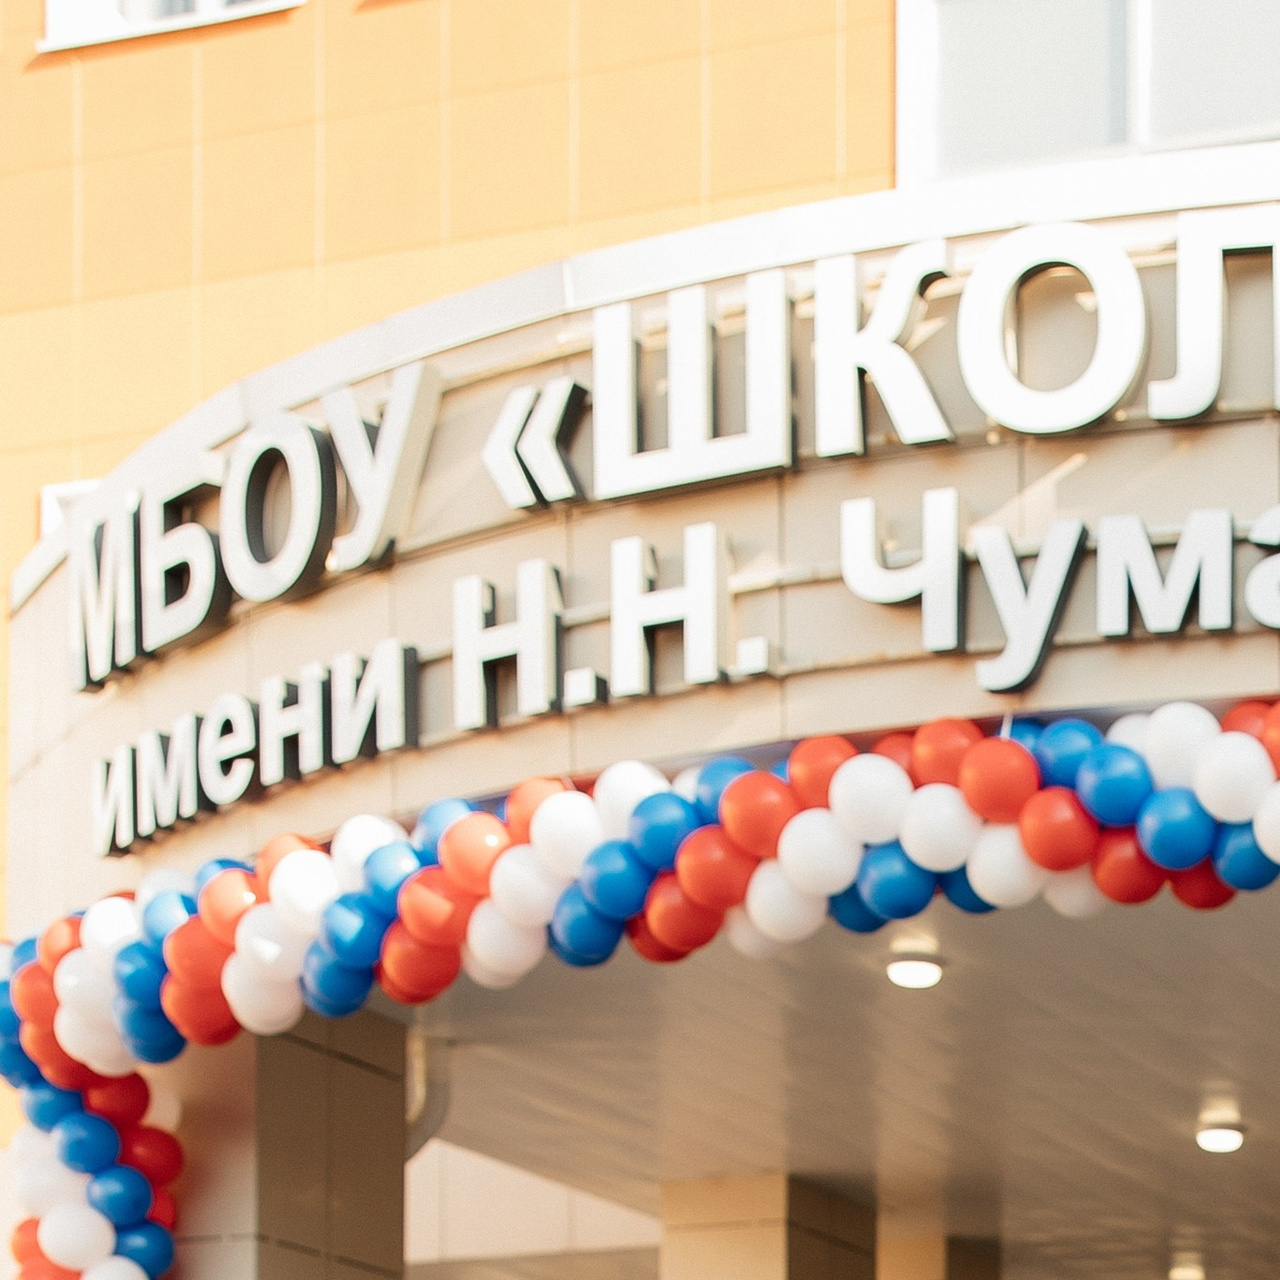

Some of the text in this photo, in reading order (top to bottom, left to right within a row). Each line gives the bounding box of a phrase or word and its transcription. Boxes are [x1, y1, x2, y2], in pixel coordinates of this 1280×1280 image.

[70, 360, 438, 692] МБОУ
[92, 636, 418, 856] имени
[452, 521, 772, 732] Н.Н.
